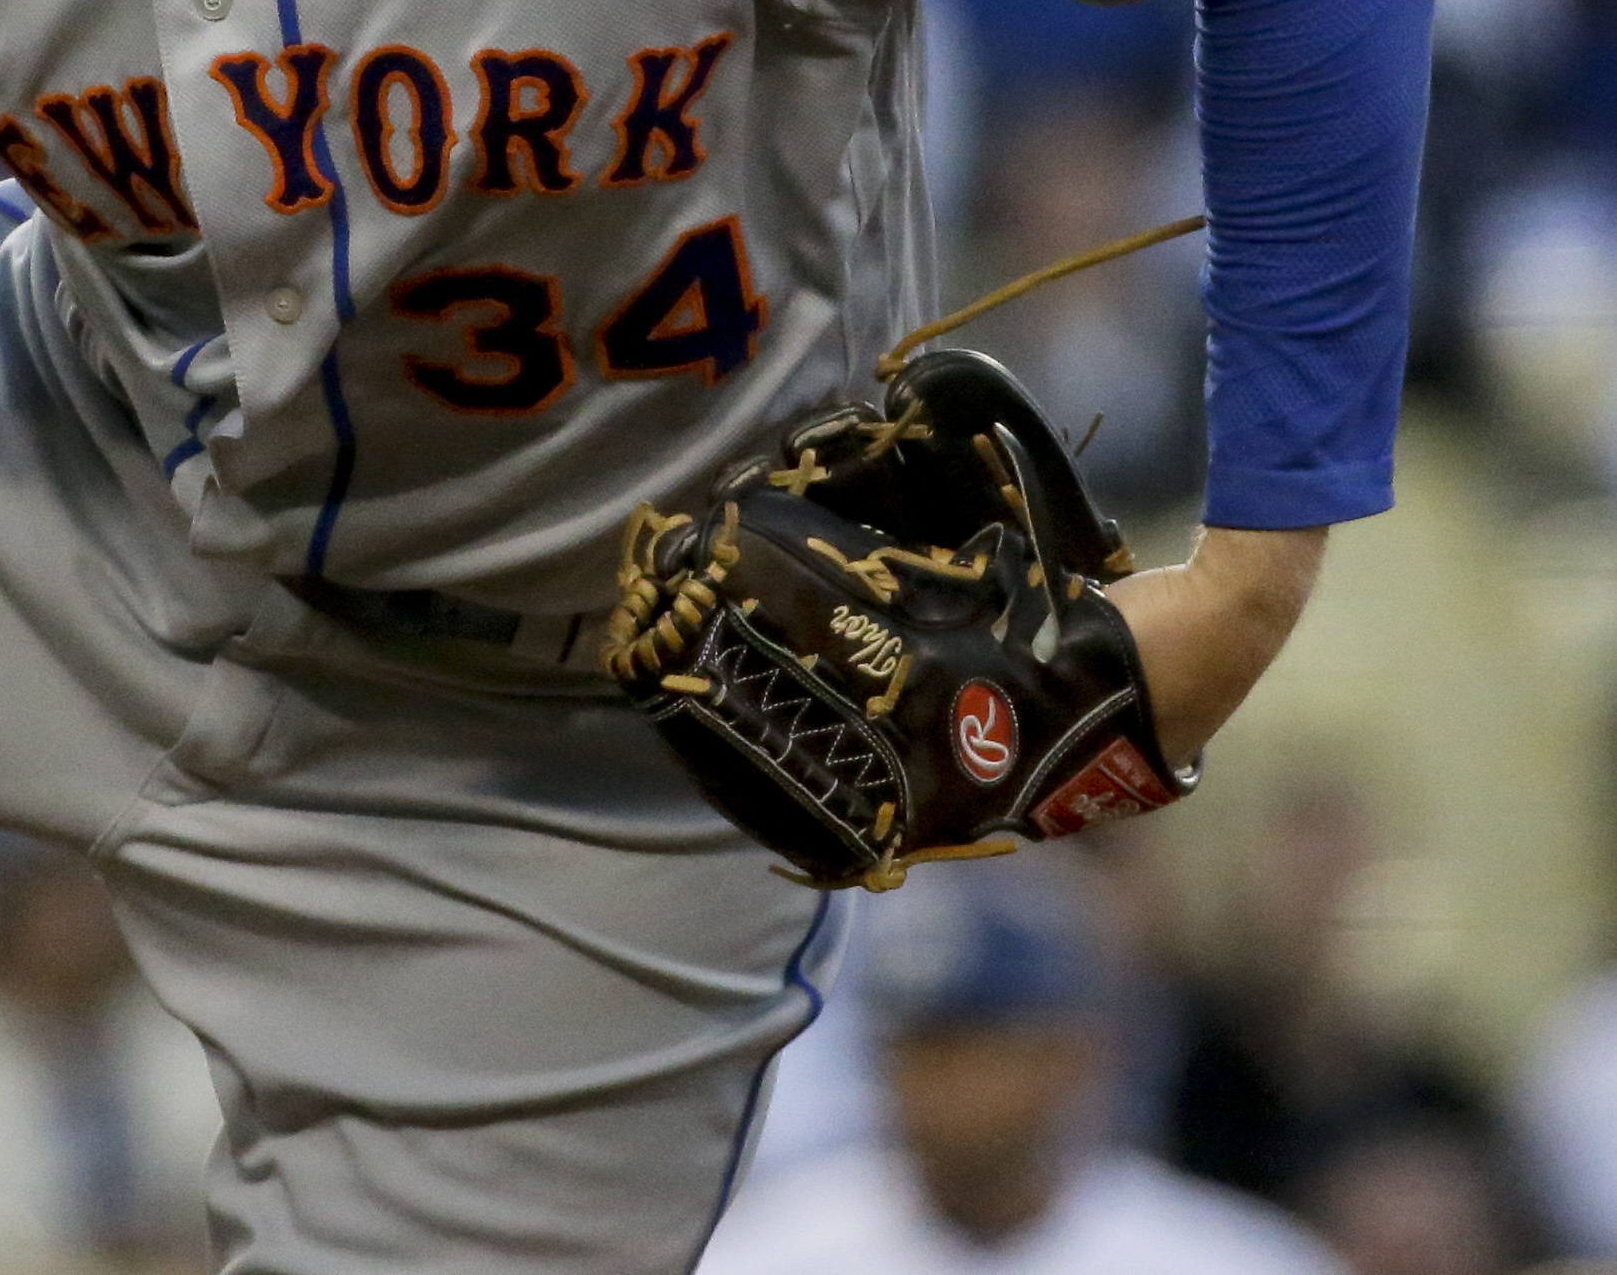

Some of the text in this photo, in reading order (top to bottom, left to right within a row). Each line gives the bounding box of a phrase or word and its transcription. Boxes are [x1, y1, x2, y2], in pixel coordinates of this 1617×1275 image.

[209, 30, 734, 216] YORK
[390, 216, 769, 417] 34
[832, 605, 904, 677] Thor
[959, 696, 1010, 770] R
